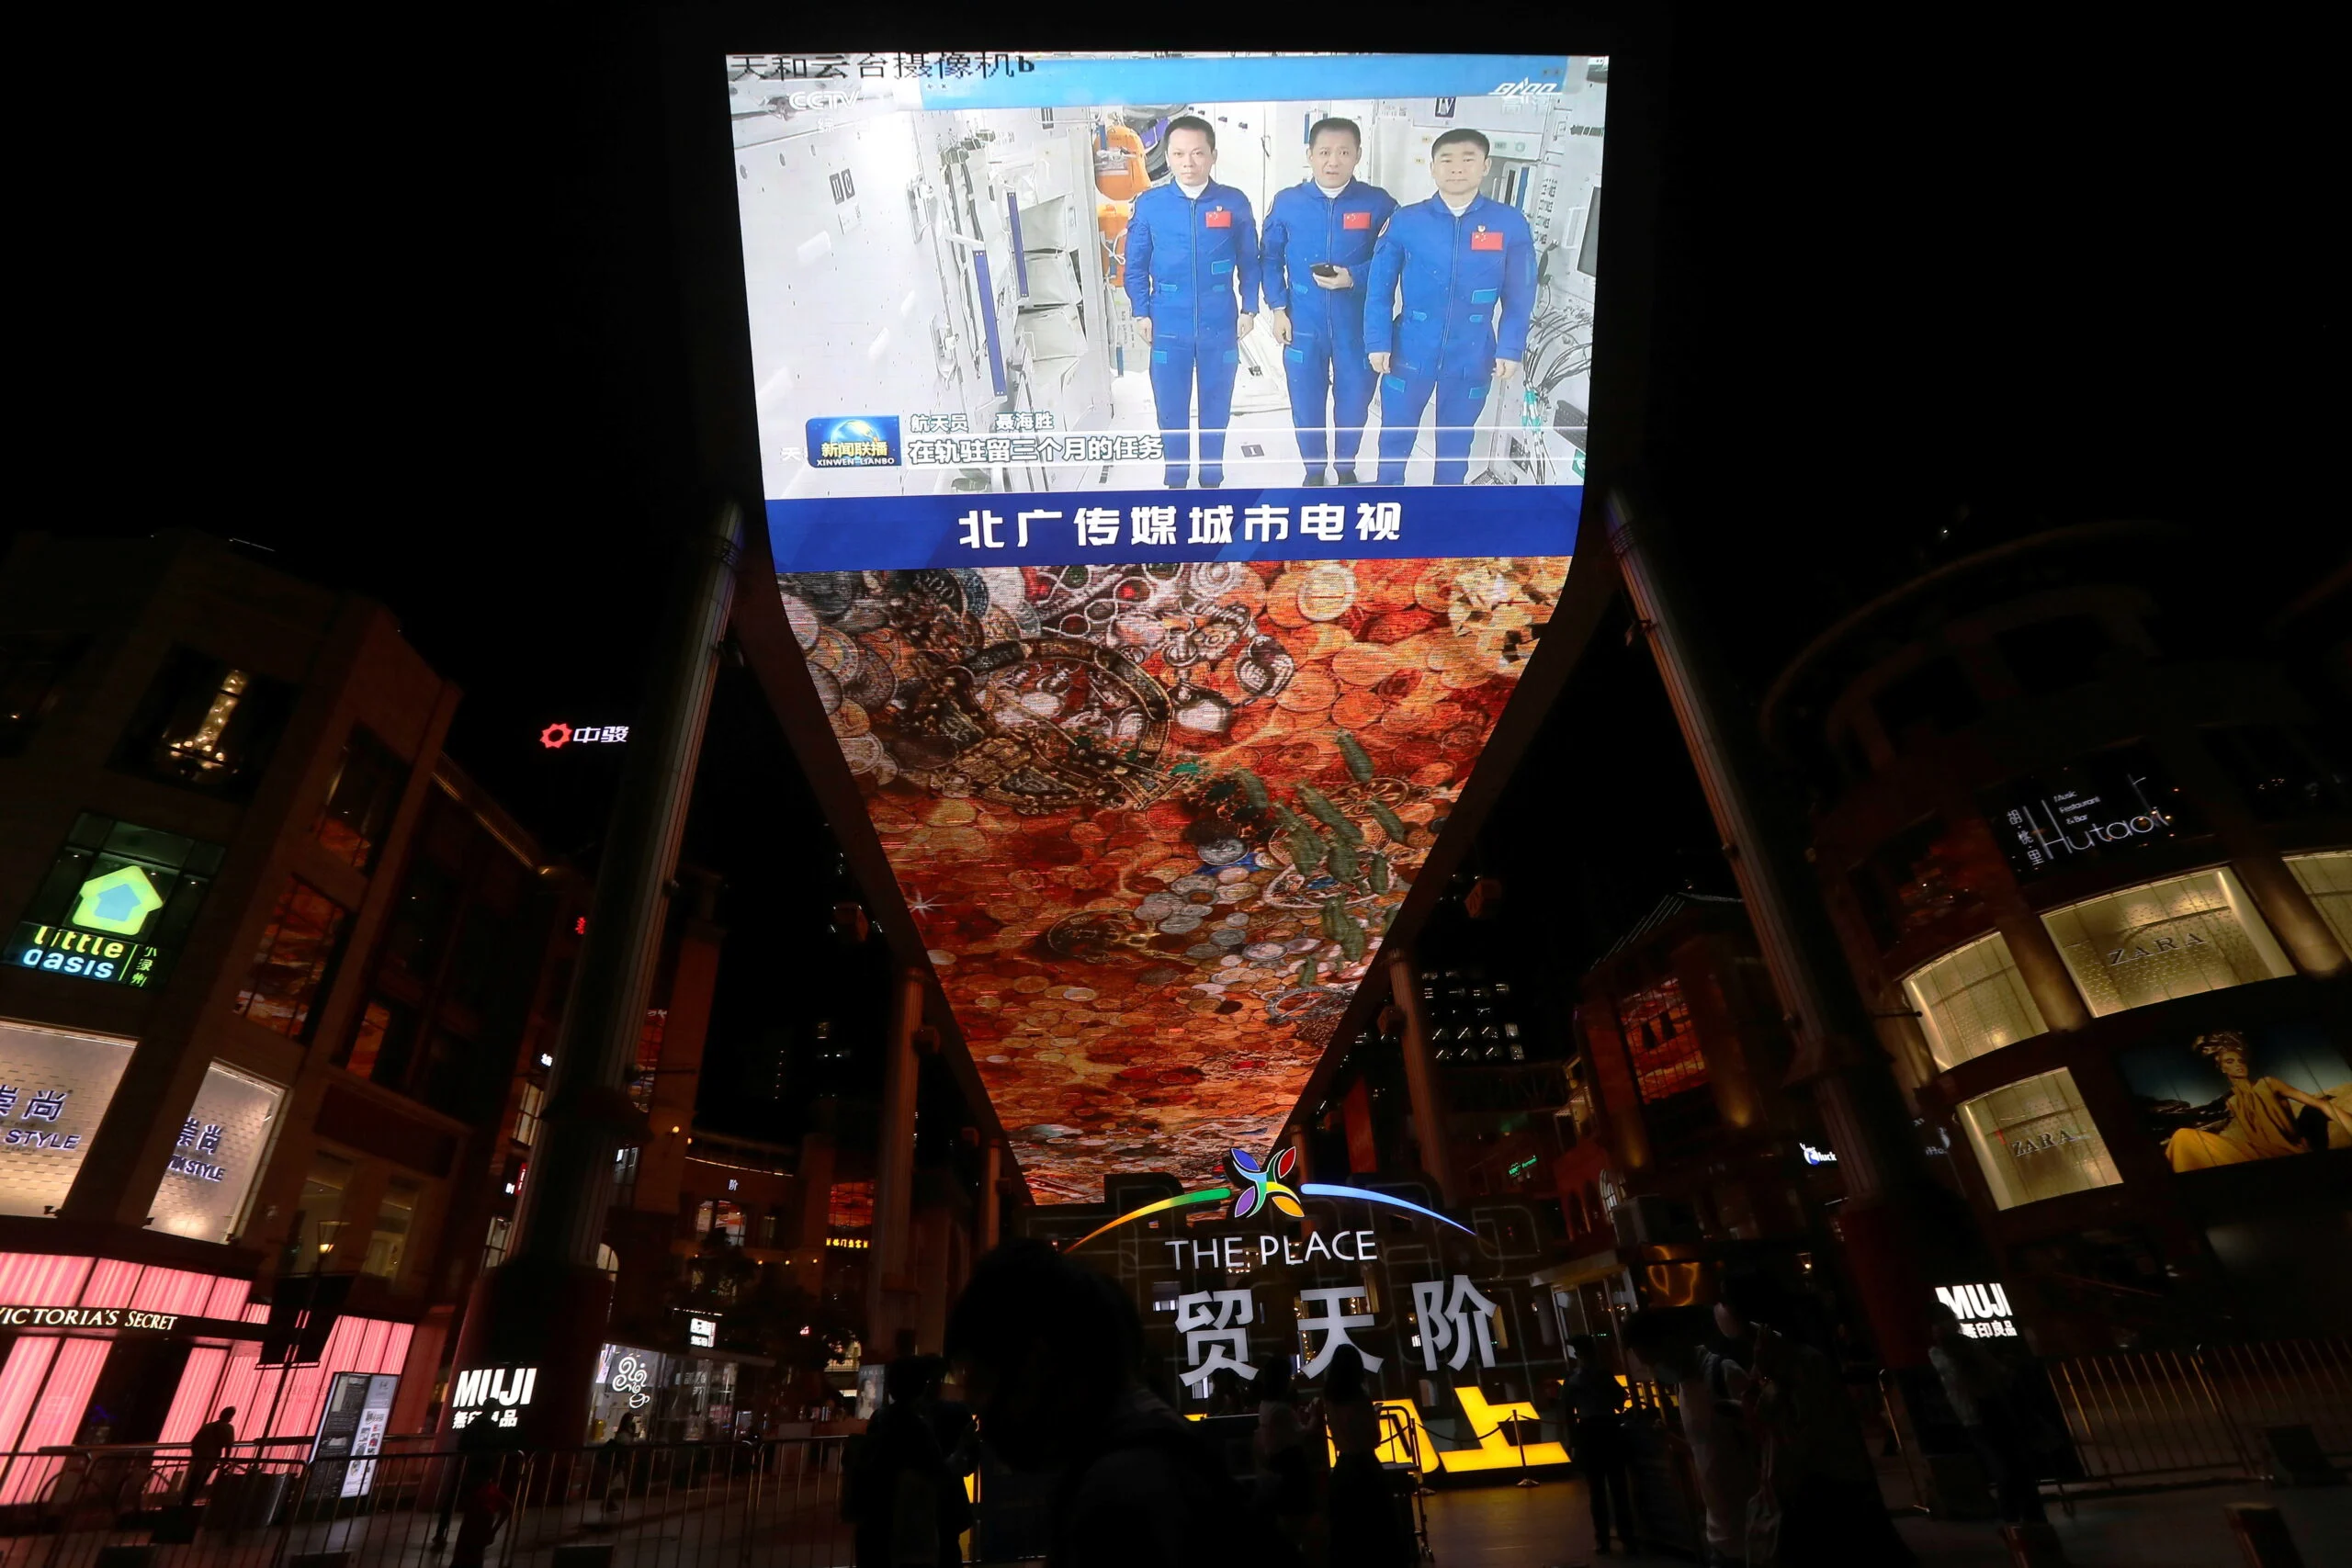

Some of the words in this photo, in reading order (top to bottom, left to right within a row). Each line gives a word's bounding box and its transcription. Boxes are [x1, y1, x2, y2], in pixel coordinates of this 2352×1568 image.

[789, 91, 861, 110] CCTV
[910, 413, 968, 433] 航天员
[995, 412, 1055, 431] 聂海胜
[816, 458, 852, 467] XINWEN
[860, 457, 895, 466] LIANBO
[820, 441, 888, 458] 新闻联播
[909, 435, 1164, 464] 在轨驻留三个月的任务
[958, 502, 1403, 549] 北广传媒城市电视
[572, 726, 629, 744] 中骏
[2108, 932, 2208, 966] ZARA
[23, 948, 115, 978] oasis
[4, 1129, 81, 1150] STYLE
[2012, 1129, 2076, 1157] ZARA
[184, 1158, 226, 1182] STYLE
[1165, 1236, 1245, 1269] THE
[1260, 1230, 1378, 1266] PLACE
[1935, 1282, 2013, 1320] MUJI
[0, 1307, 120, 1325] ICTORIA'S
[124, 1310, 178, 1330] SECRET
[452, 1368, 537, 1408] MUJI
